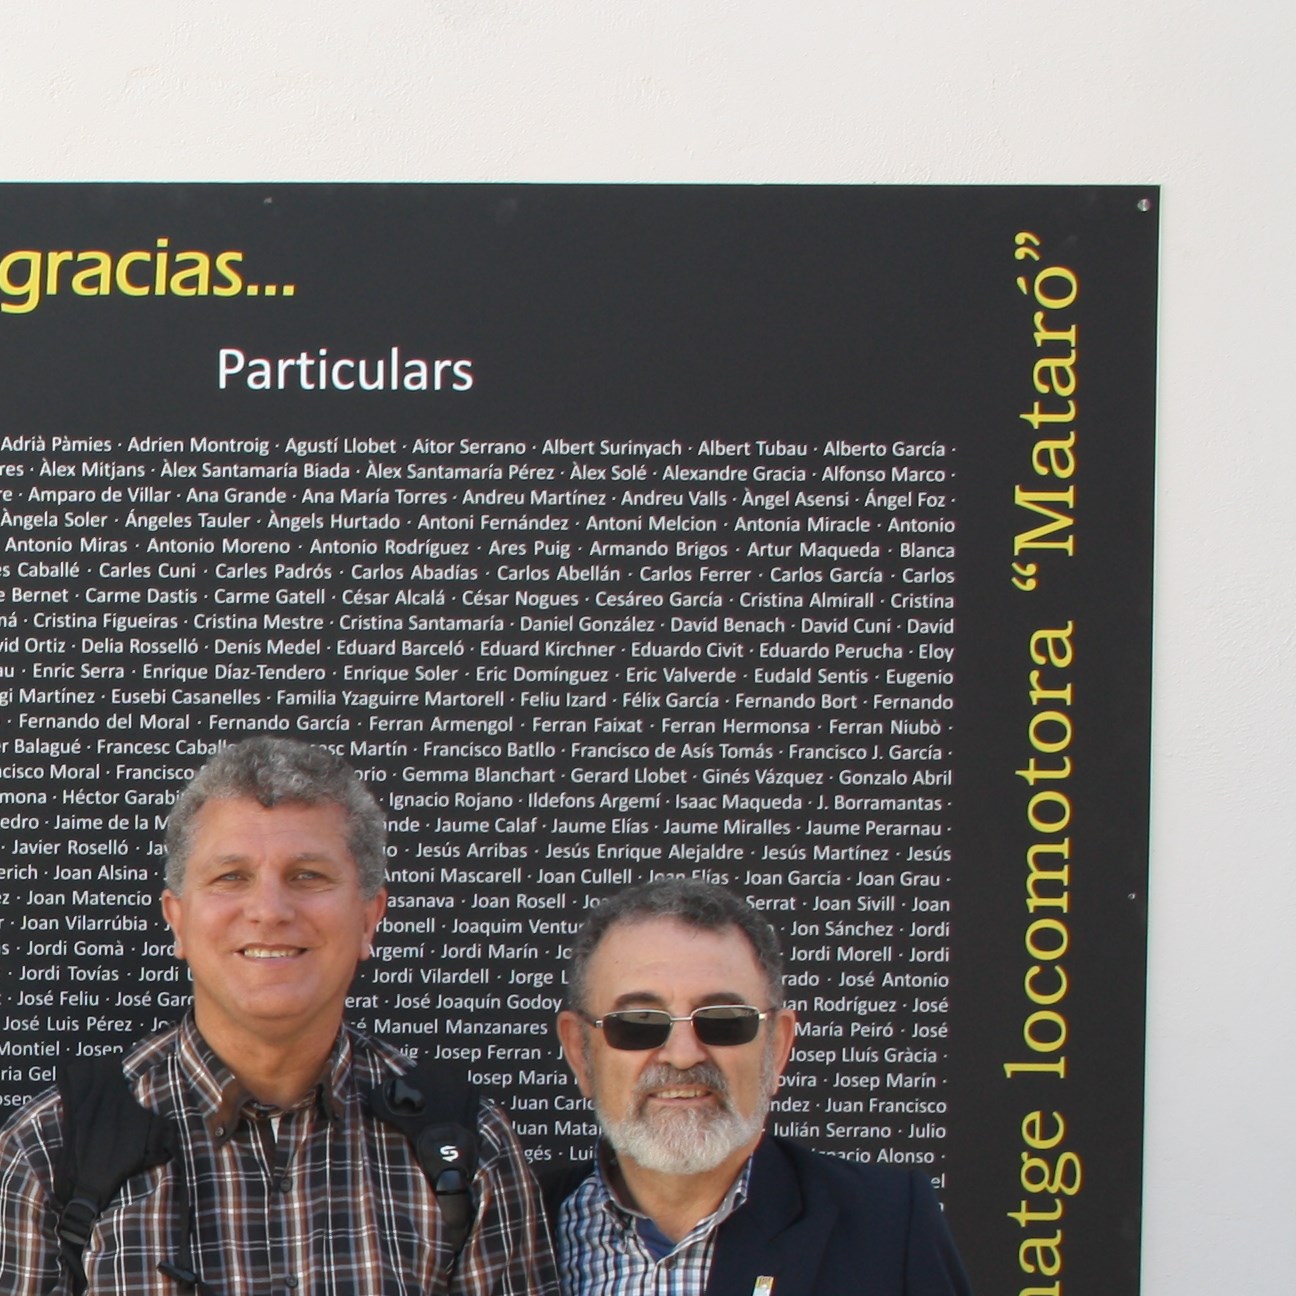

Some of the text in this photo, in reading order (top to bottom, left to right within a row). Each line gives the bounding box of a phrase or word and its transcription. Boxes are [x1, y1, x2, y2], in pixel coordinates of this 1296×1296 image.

[219, 346, 474, 391] Particulars
[0, 435, 46, 452] Adrià
[51, 435, 112, 452] Pàmies
[127, 435, 184, 453] Adrien
[190, 436, 270, 457] Montroig
[284, 436, 339, 457] Agustí
[344, 437, 397, 454] Llobet
[411, 438, 456, 454] Aitor
[459, 438, 527, 455] Serrano
[541, 438, 595, 456] Albert
[599, 439, 682, 459] Surinyach
[697, 439, 751, 457] Albert
[755, 440, 808, 457] Tubau
[823, 440, 887, 457] Alberto
[892, 440, 946, 457] García
[1003, 620, 1073, 1079] locomotora
[53, 864, 92, 881] Joan
[97, 864, 148, 881] Alsina
[790, 920, 950, 938] Jon Sánchez Jordi
[790, 1046, 937, 1066] Josep Lluís Gràcia
